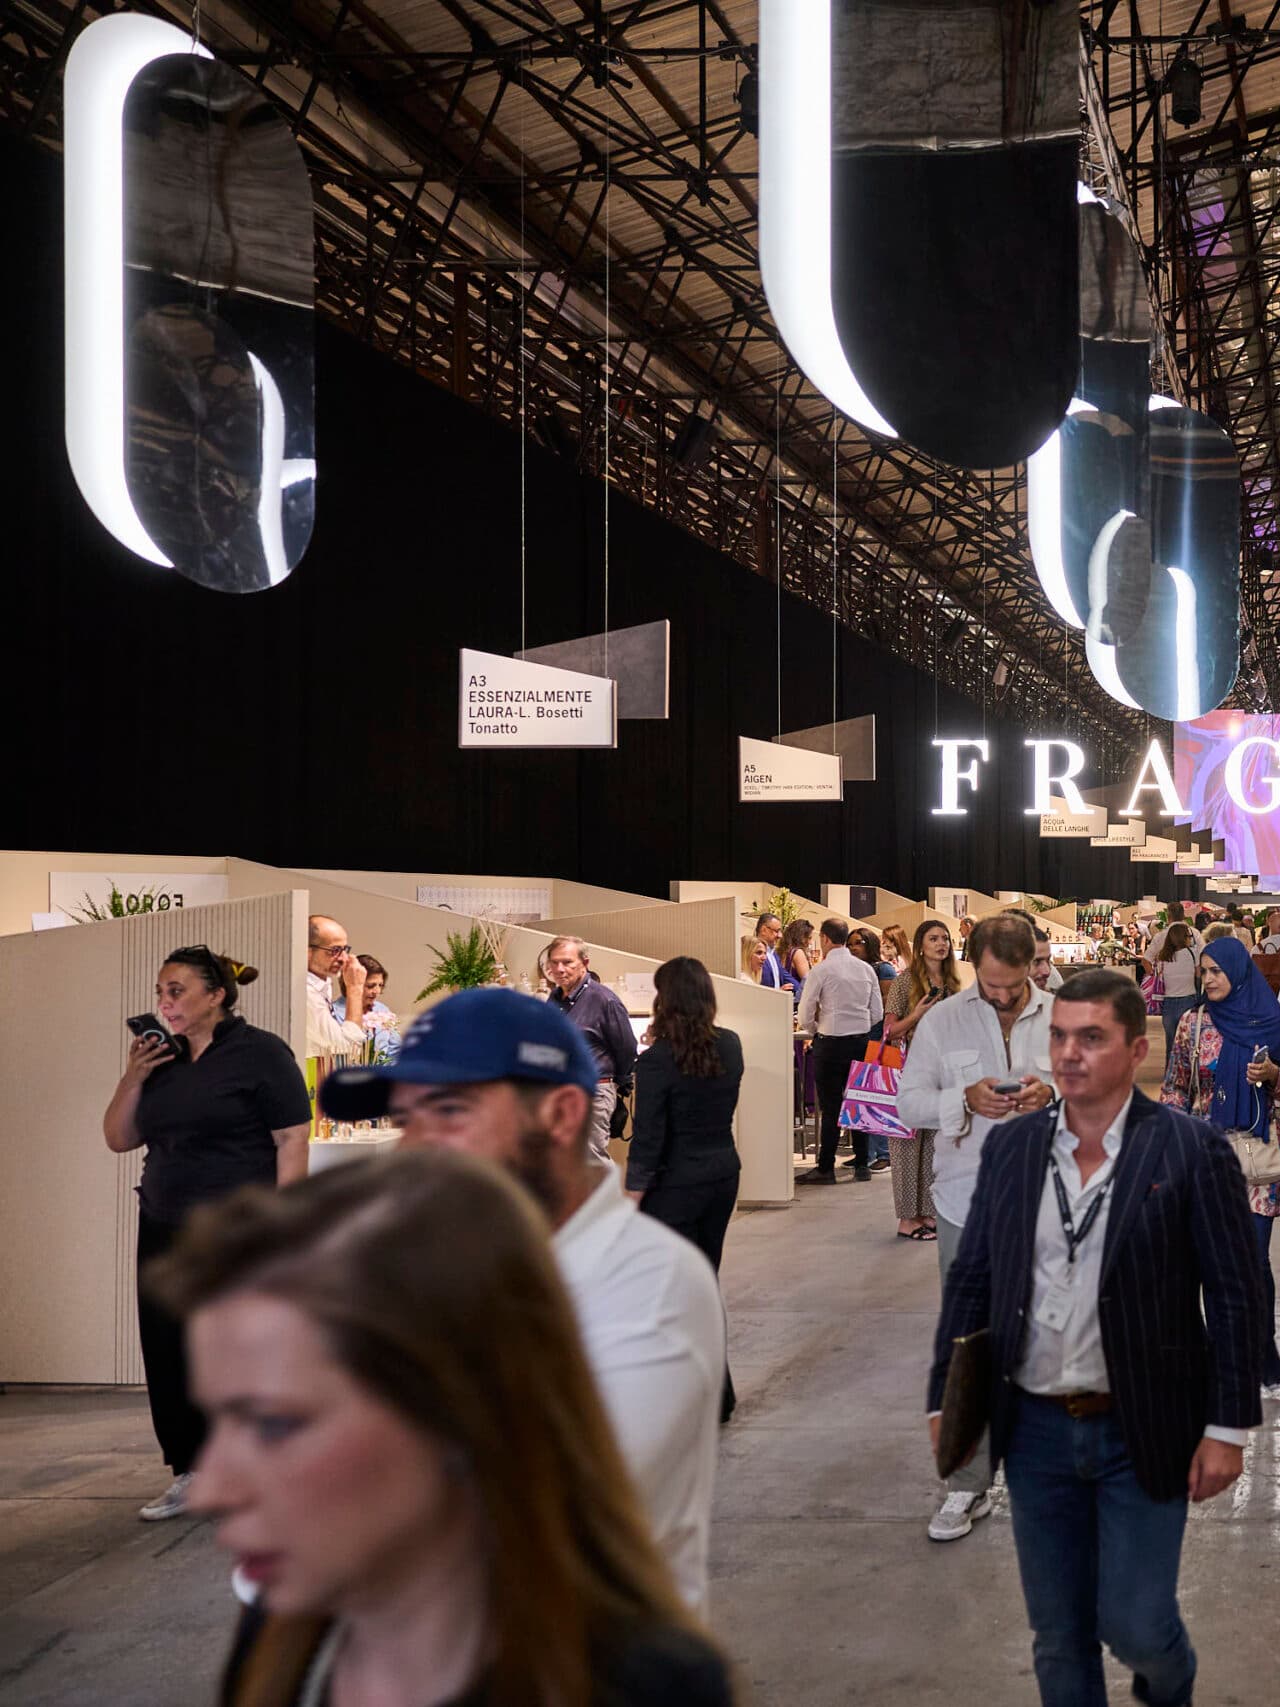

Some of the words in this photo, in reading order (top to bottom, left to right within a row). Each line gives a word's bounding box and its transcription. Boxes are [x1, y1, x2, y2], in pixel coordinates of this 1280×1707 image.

[468, 674, 487, 688] A3
[468, 690, 593, 703] ESSENZIALMENTE
[468, 706, 531, 719] LAURA-L.
[536, 706, 584, 719] Bosetti
[468, 722, 518, 735] Tonatto
[743, 764, 757, 774] A5
[743, 774, 773, 784] AIGEN
[1042, 818, 1065, 826] ACQUA
[1042, 825, 1063, 833] DELLE
[1064, 825, 1090, 833] LANGHE
